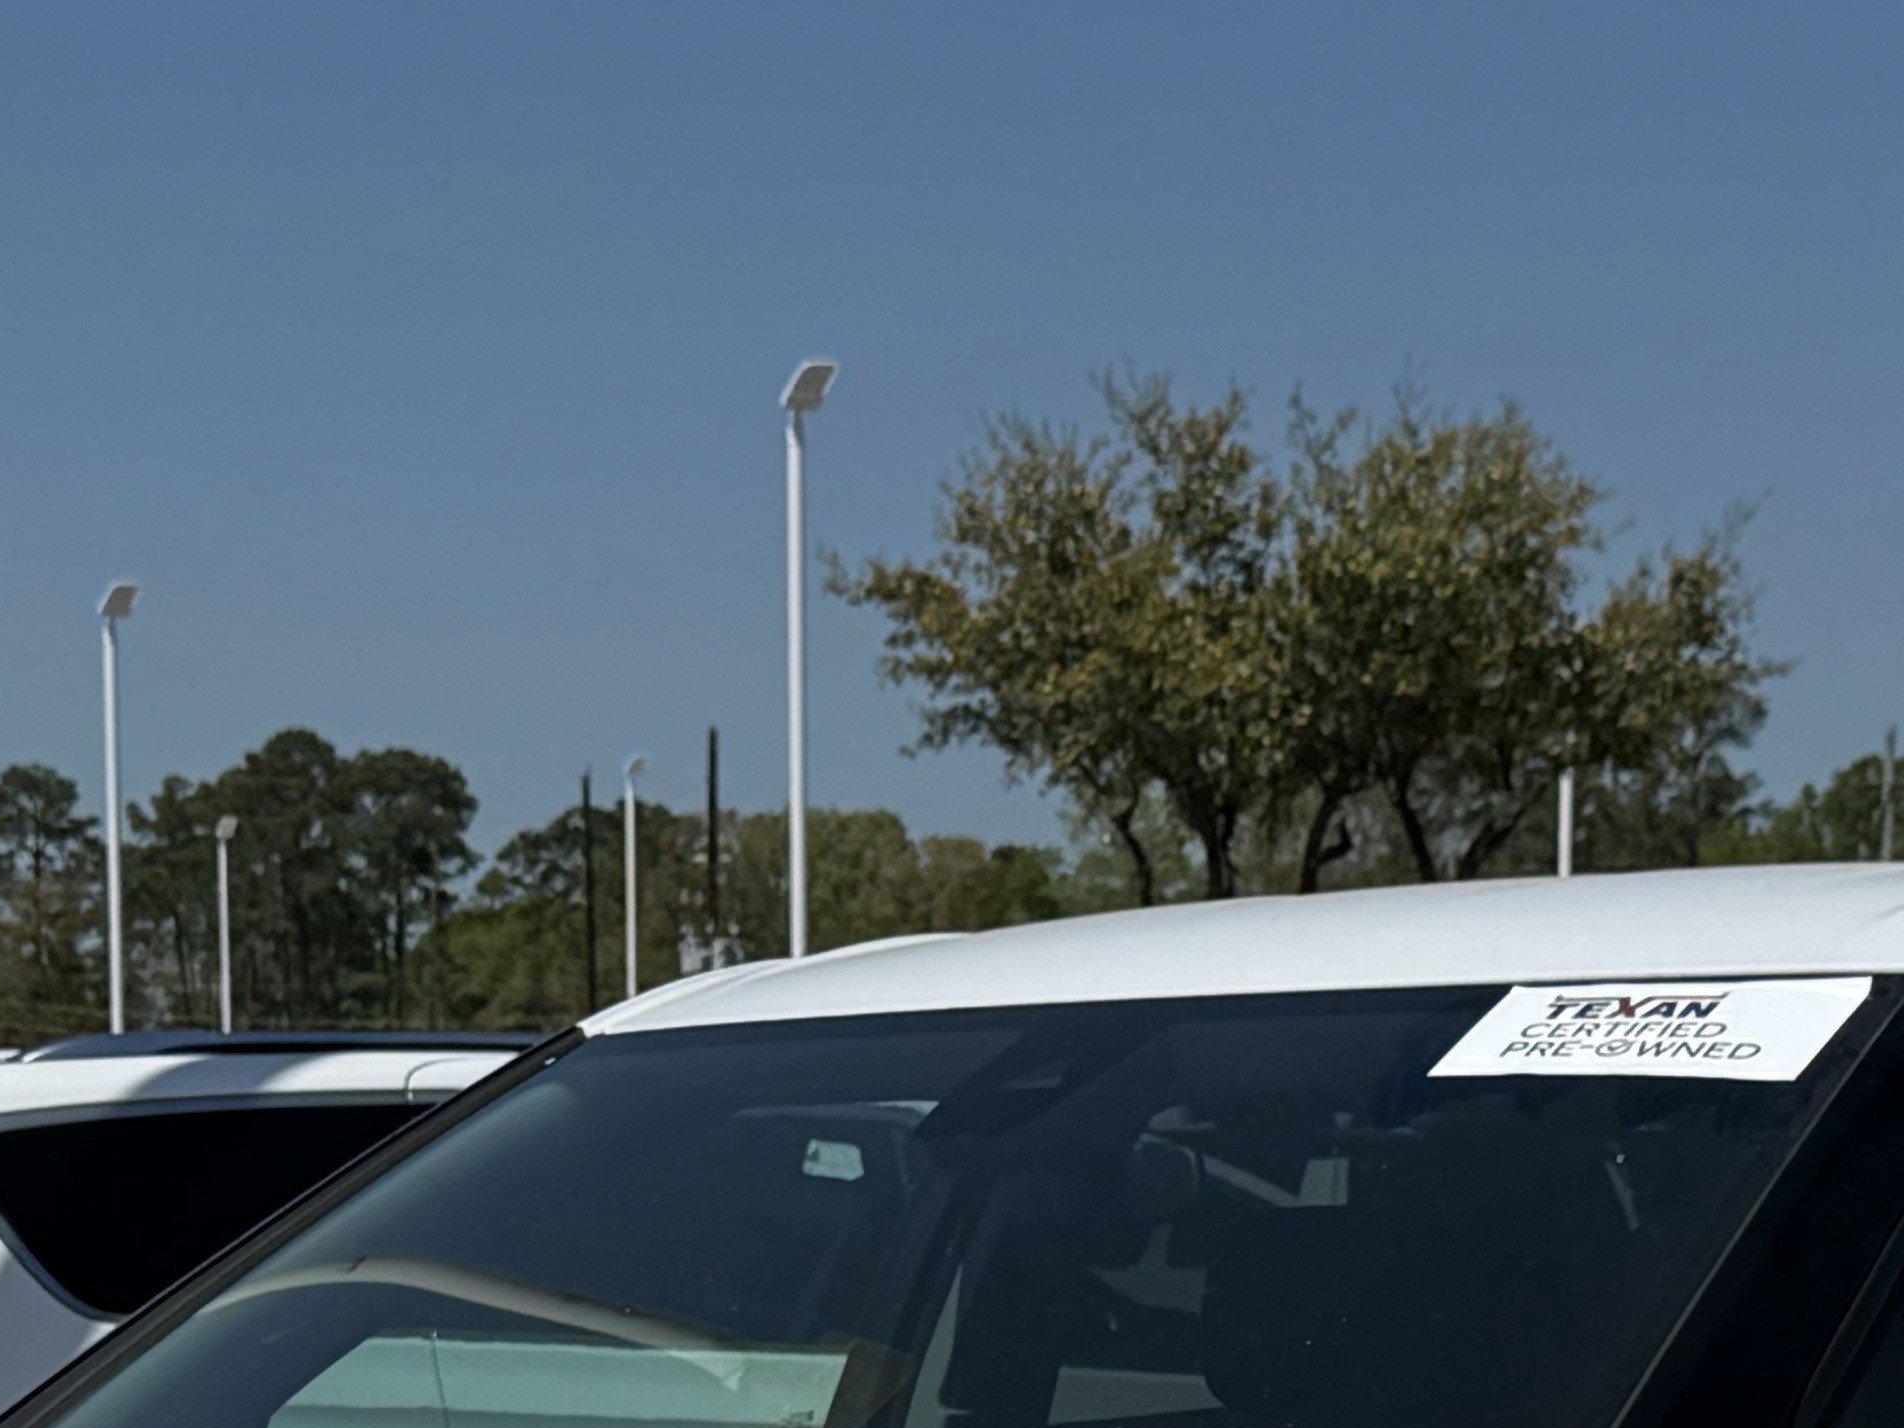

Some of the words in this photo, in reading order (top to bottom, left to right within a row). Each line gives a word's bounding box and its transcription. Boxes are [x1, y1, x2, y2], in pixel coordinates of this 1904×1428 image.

[1546, 992, 1731, 1019] TEXAN
[1520, 1021, 1728, 1039] CERTIFIED
[1499, 1039, 1762, 1060] PRE-OWNED
